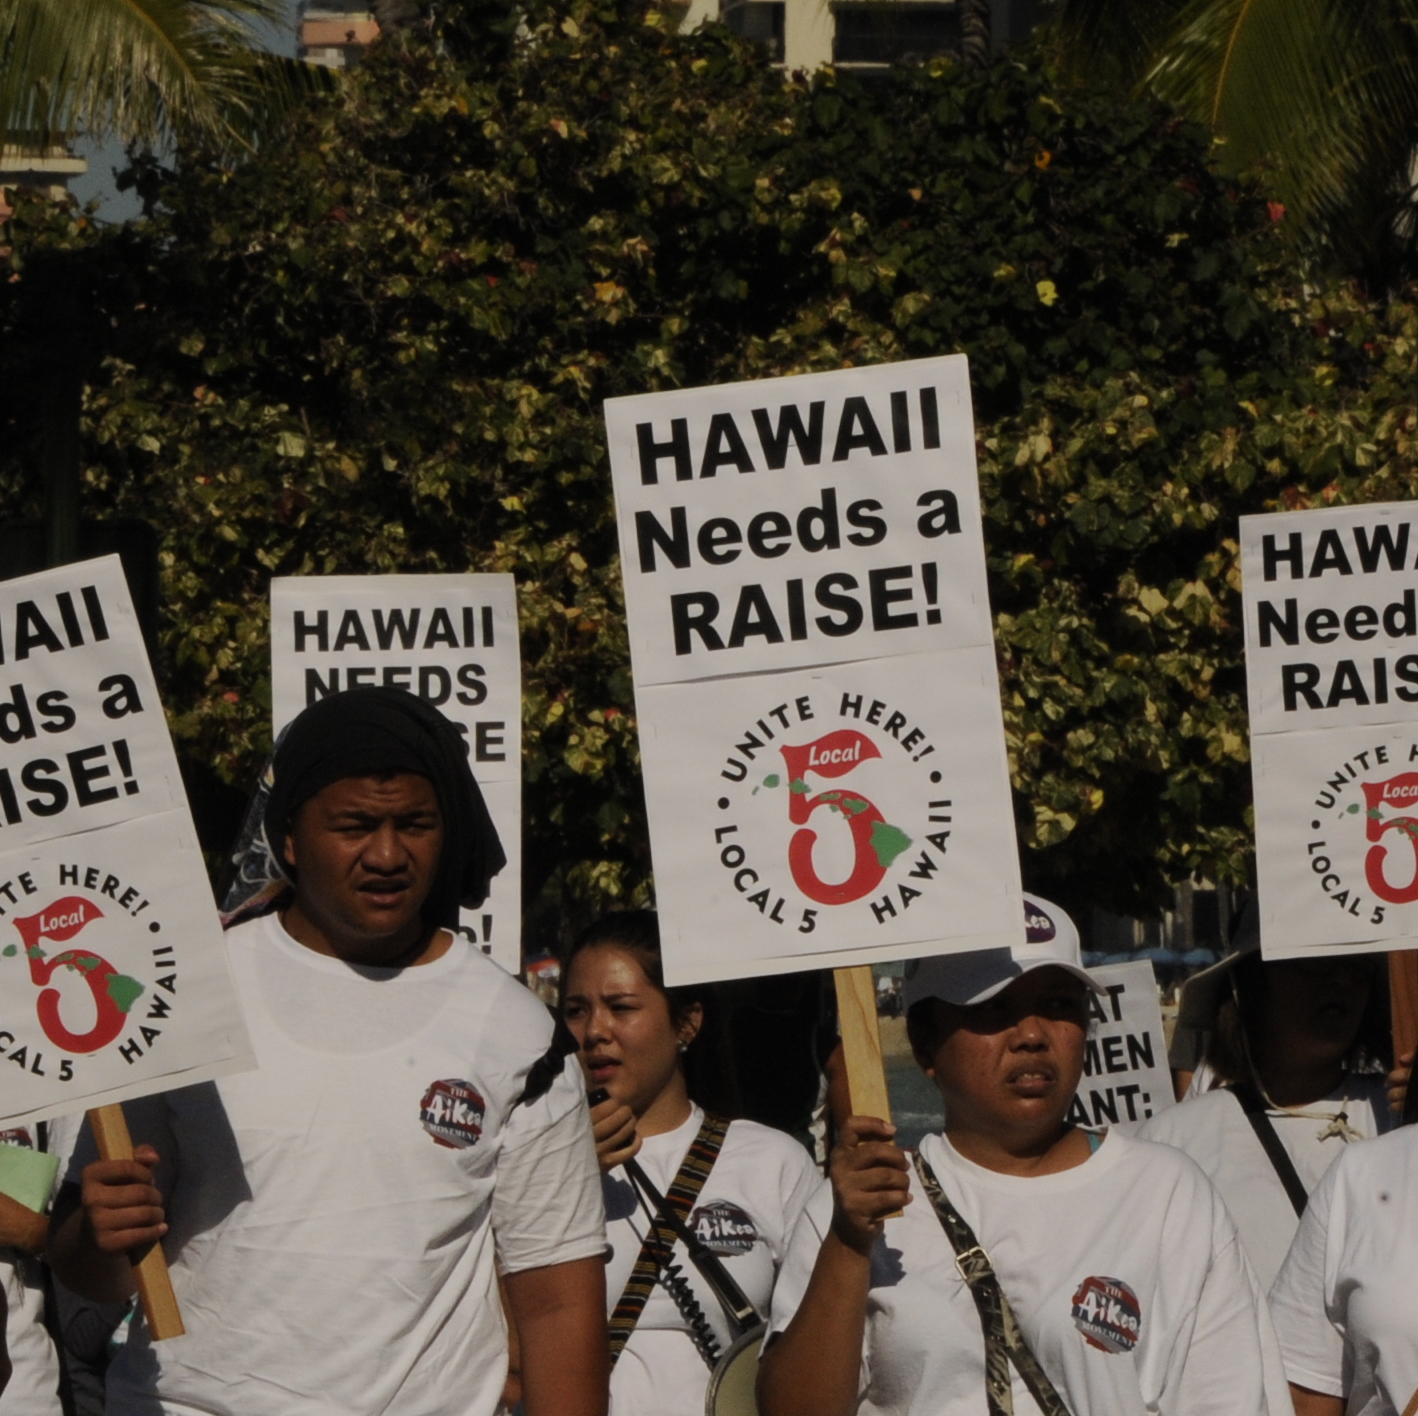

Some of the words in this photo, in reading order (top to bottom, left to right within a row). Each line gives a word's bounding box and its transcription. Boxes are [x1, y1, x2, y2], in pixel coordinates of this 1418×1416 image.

[636, 387, 940, 485] HAWAII
[635, 487, 887, 573] Needs
[917, 490, 961, 538] a
[294, 606, 494, 652] HAWAII
[671, 562, 941, 655] RAISE!
[99, 674, 143, 719] a
[721, 696, 813, 786] UNITE
[840, 693, 934, 761] HERE!
[807, 739, 863, 765] Local
[1316, 746, 1388, 813] UNITE
[780, 729, 888, 906] 5
[60, 864, 149, 916] HERE!
[715, 825, 784, 924] LOCAL
[799, 909, 817, 933] 5
[870, 800, 951, 924] HAWAII
[1308, 842, 1360, 916] LOCAL
[1371, 906, 1384, 924] 5
[39, 904, 86, 936] Local
[12, 896, 128, 1054] 5
[59, 1060, 73, 1081] 5
[111, 947, 176, 1064] HAWAII
[1067, 1085, 1152, 1127] ANT:
